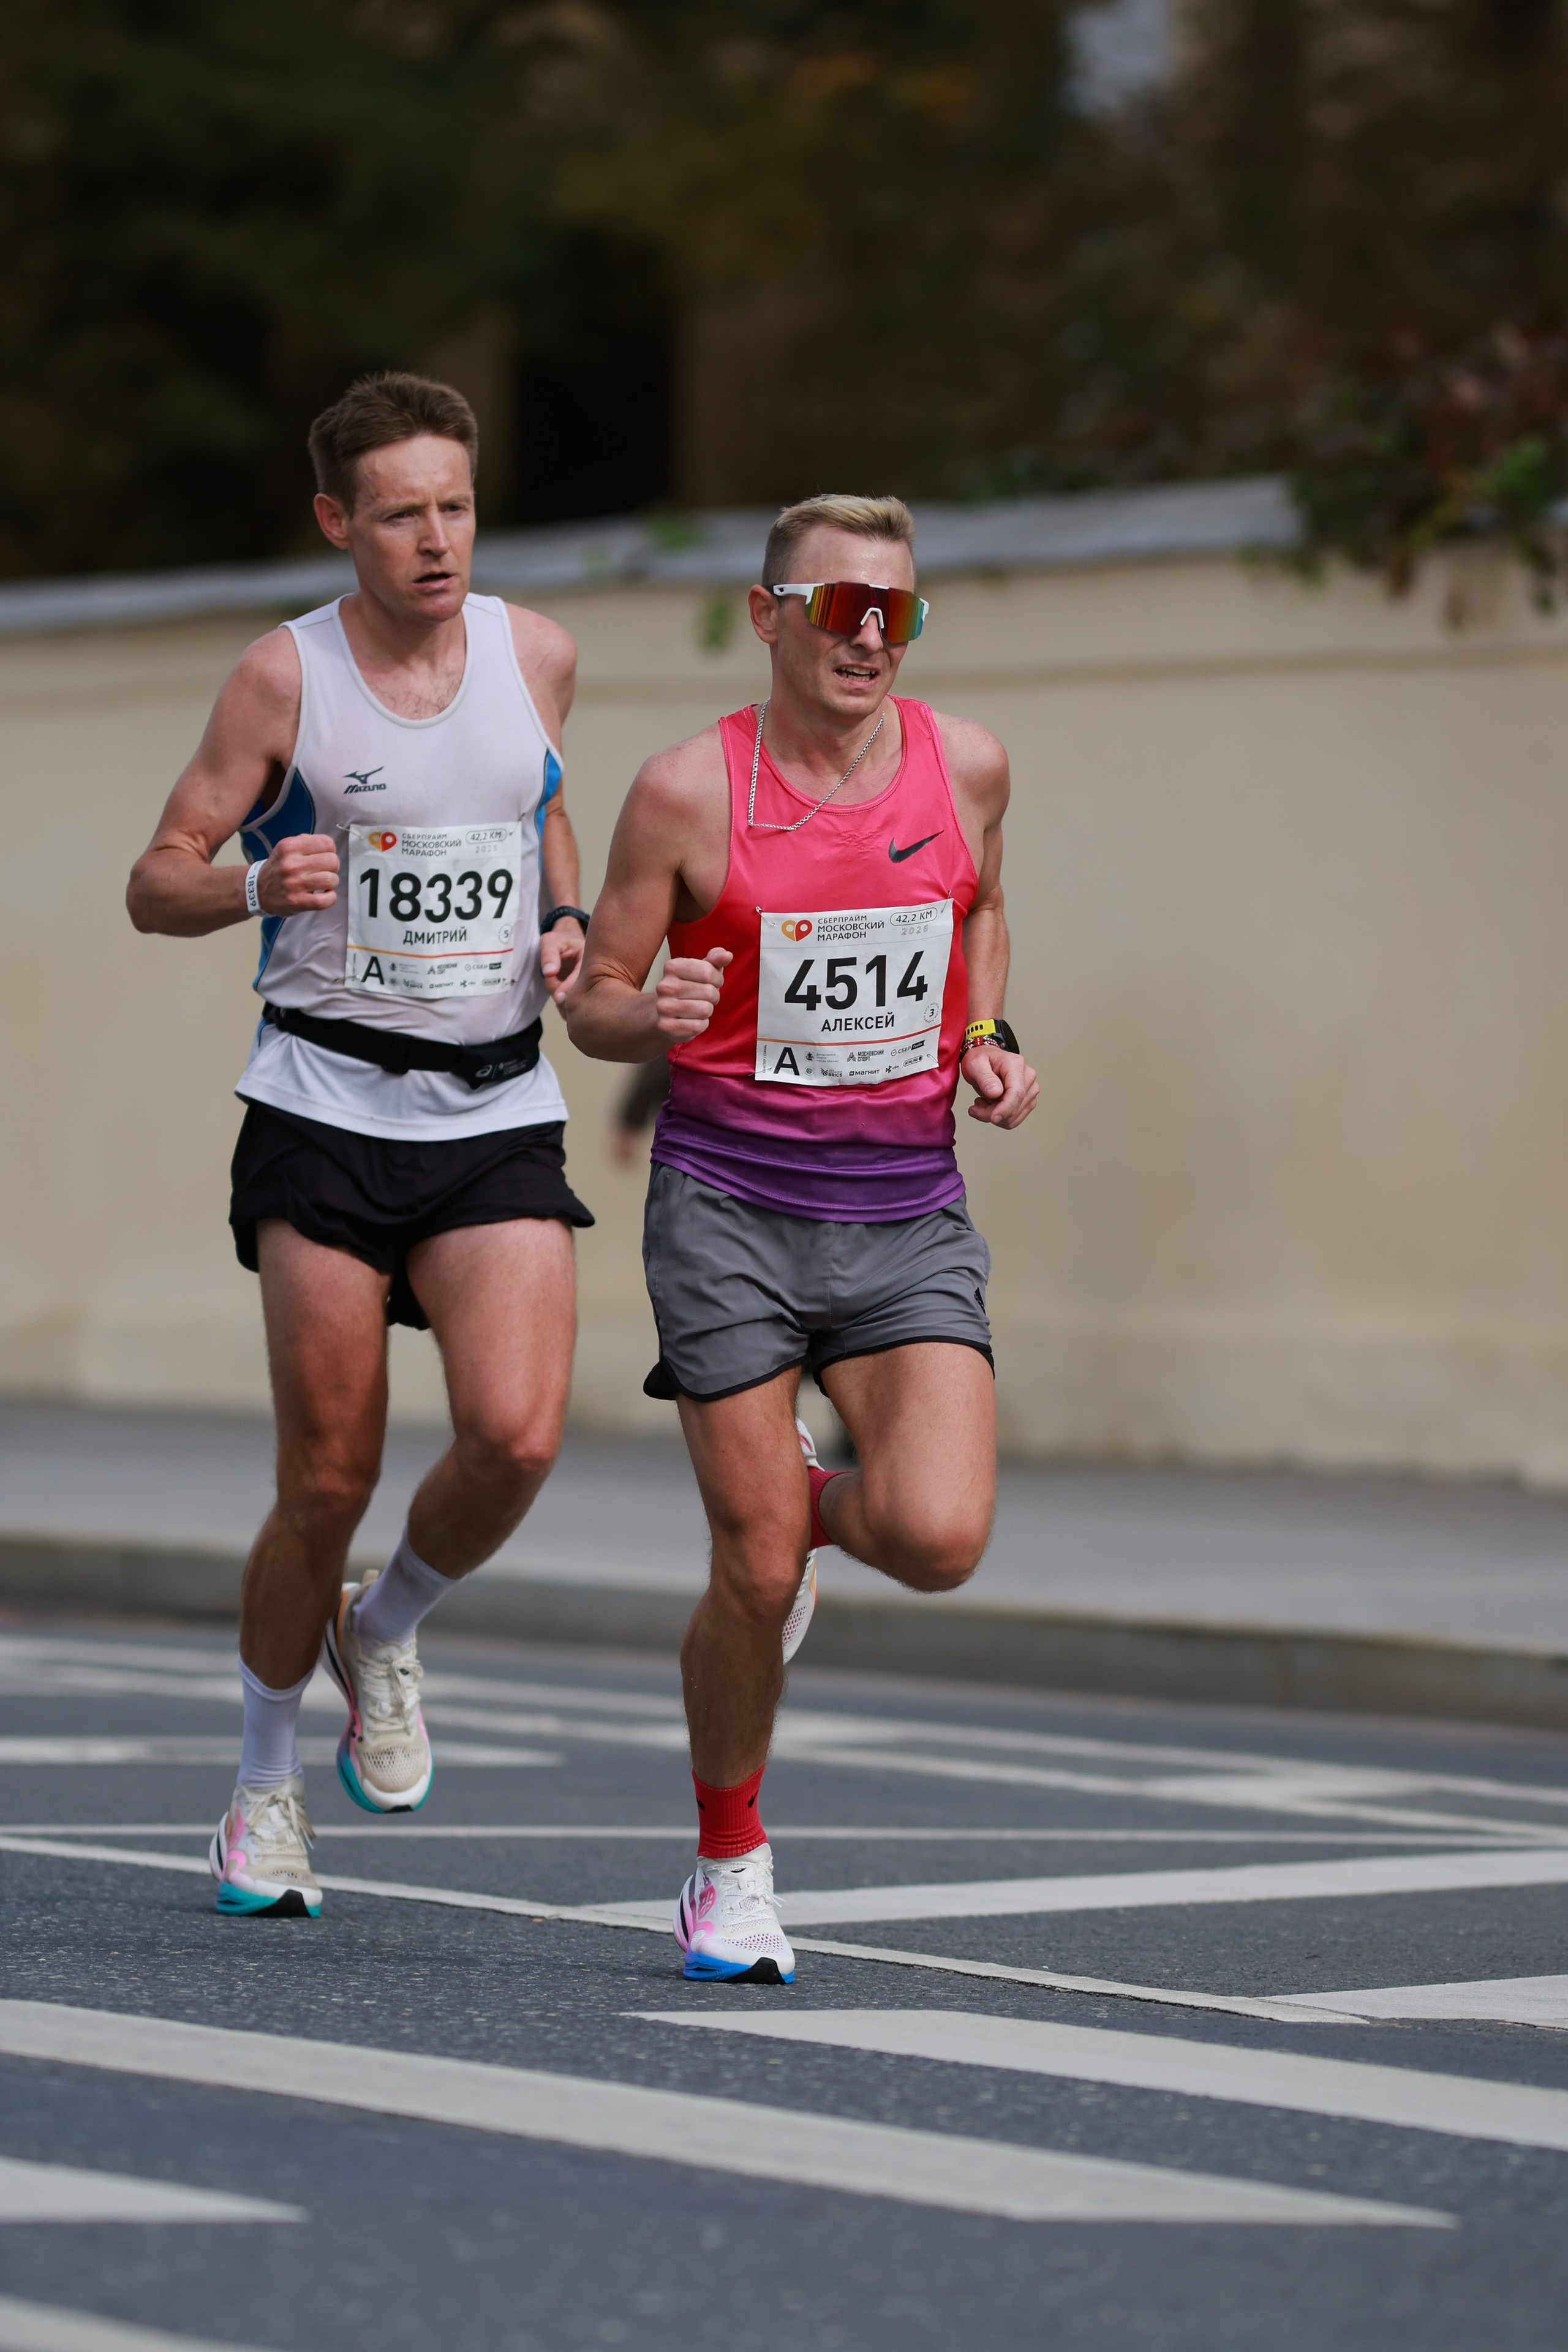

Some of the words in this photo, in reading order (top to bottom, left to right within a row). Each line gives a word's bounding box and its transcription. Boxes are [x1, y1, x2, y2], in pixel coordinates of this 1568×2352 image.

[470, 832, 487, 842] 42,2
[489, 831, 502, 840] КМ
[402, 839, 462, 849] МОСКОВСКИЙ
[402, 848, 447, 857] МАРАФОН
[247, 875, 257, 907] 18339
[360, 868, 513, 923] 18339
[818, 914, 867, 924] СБЕРПРАЙМ
[895, 914, 916, 923] 42,2
[919, 910, 932, 920] КМ
[818, 920, 884, 933] МОСКОВСКИЙ
[403, 926, 467, 945] ДМИТРИЙ
[817, 931, 867, 941] МАРАФОН
[785, 951, 928, 1011] 4514
[821, 1012, 894, 1032] АЛЕКСЕЙ
